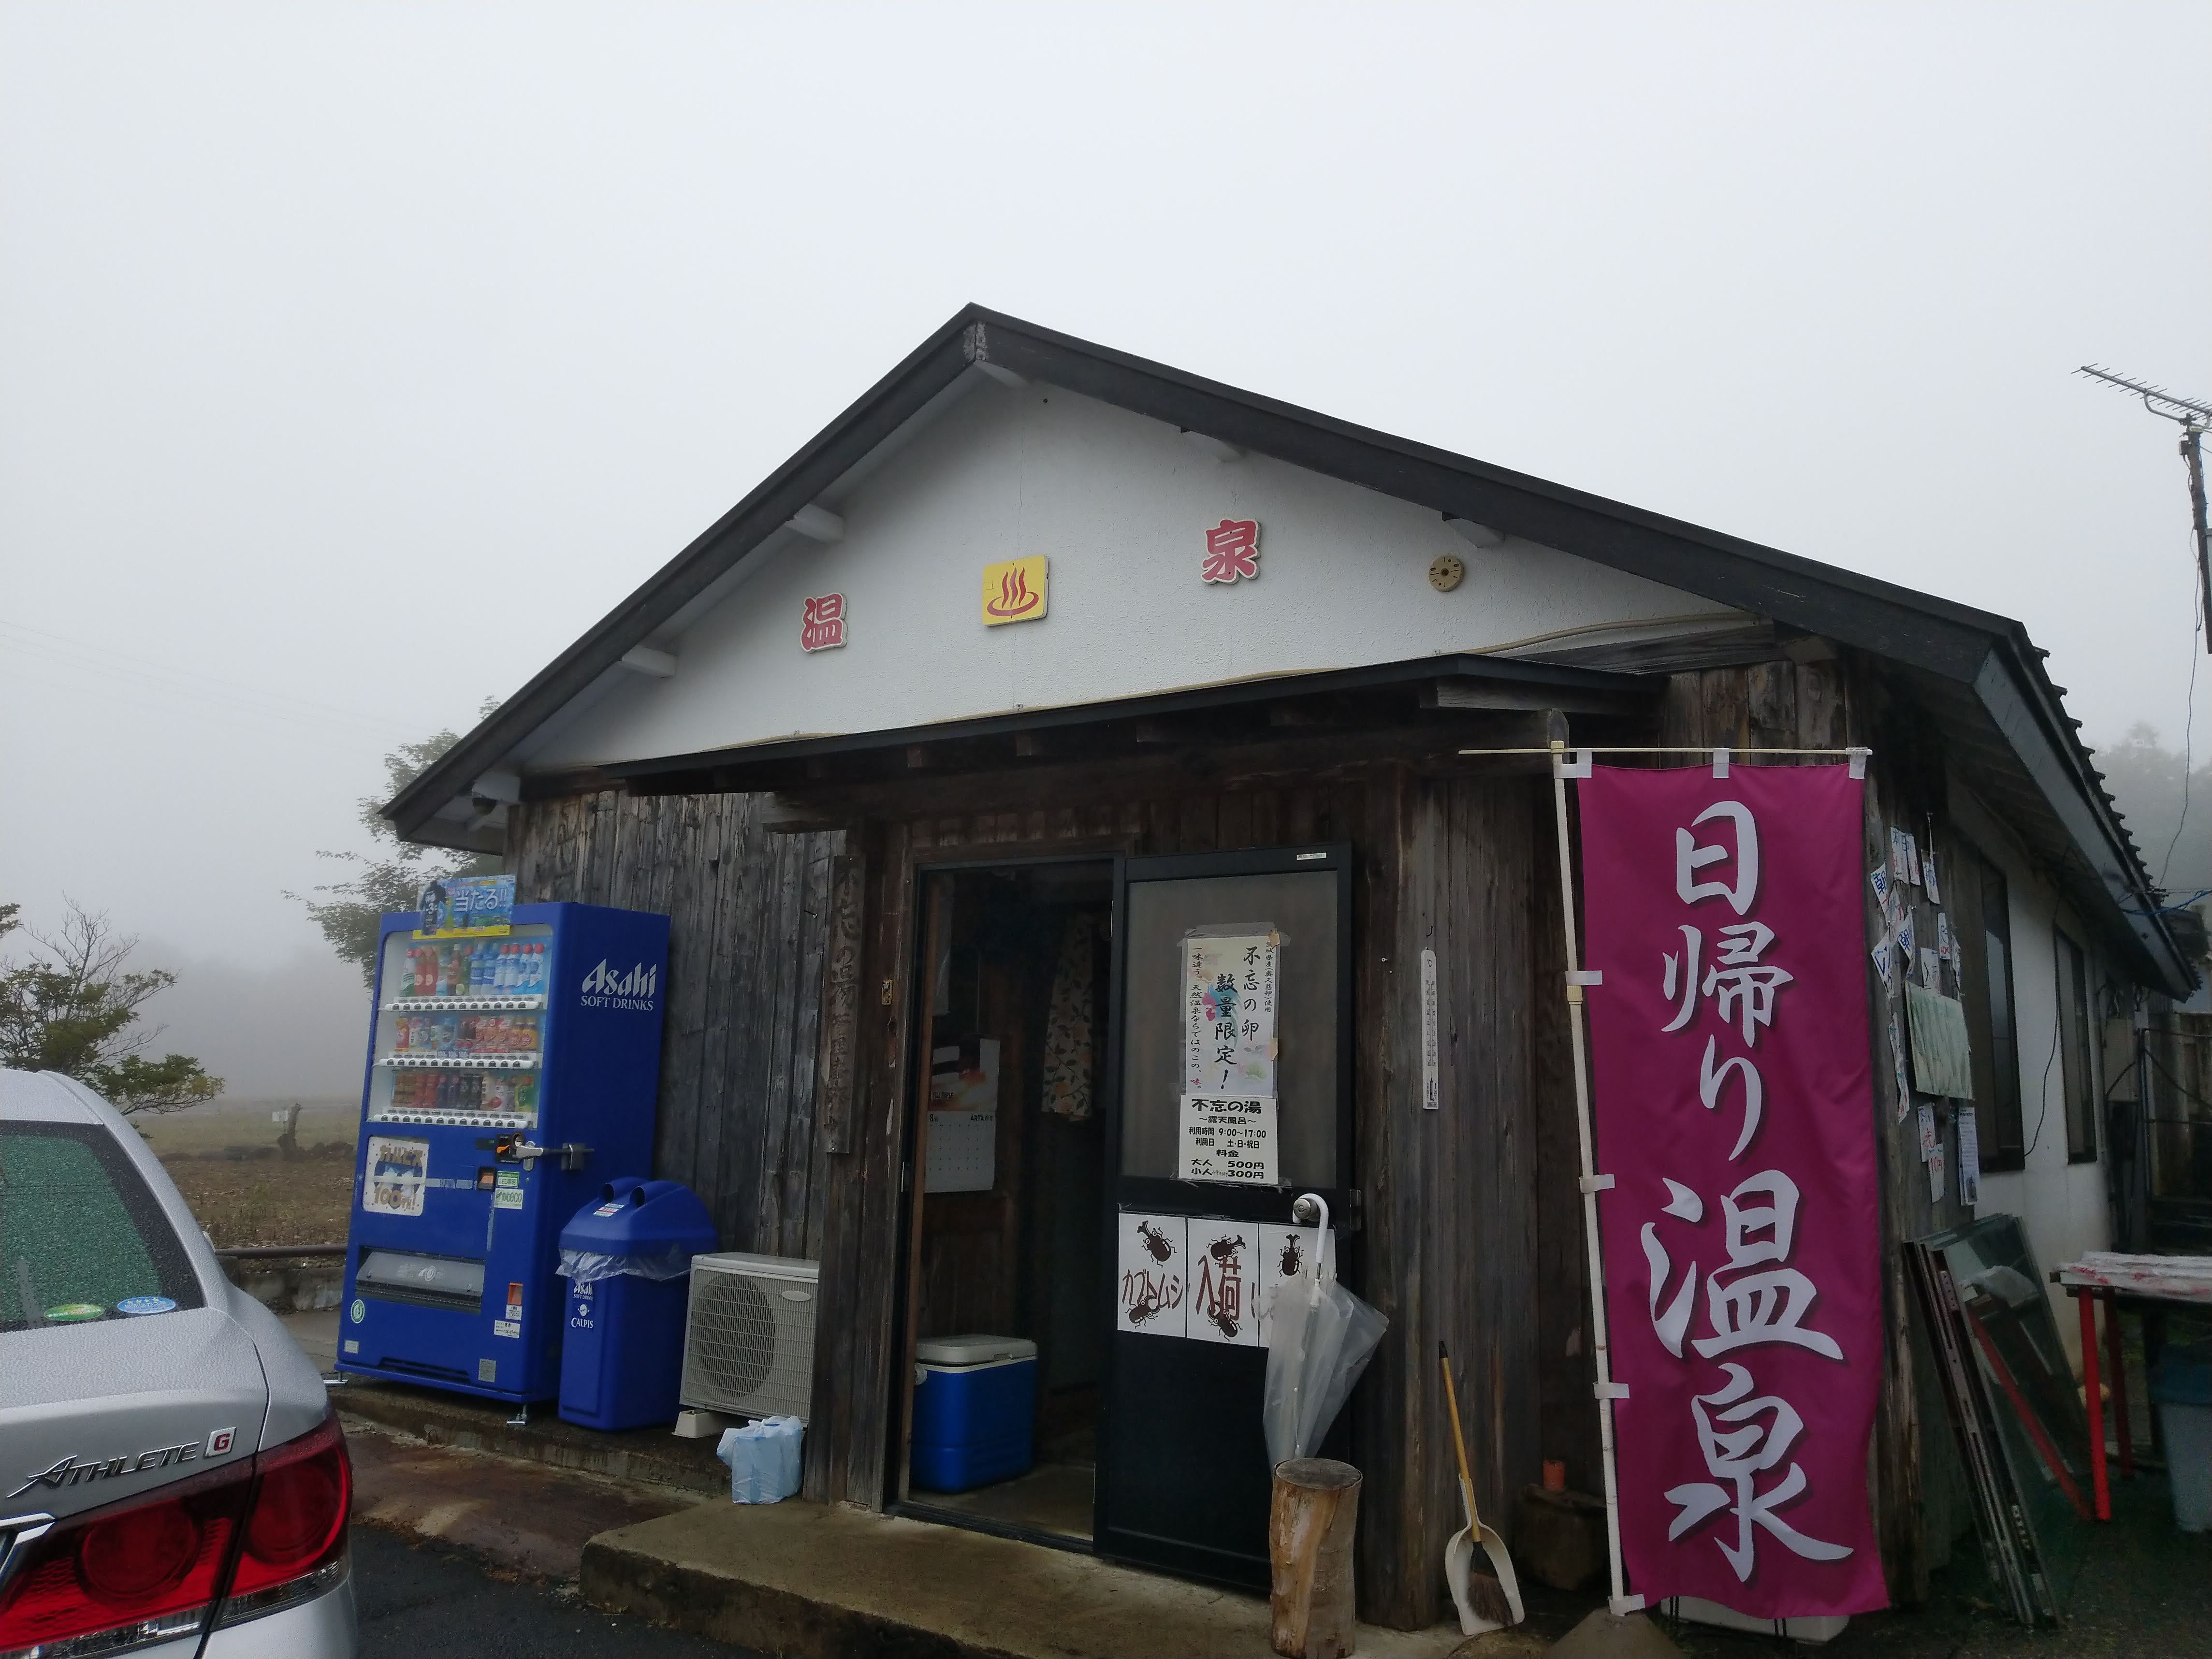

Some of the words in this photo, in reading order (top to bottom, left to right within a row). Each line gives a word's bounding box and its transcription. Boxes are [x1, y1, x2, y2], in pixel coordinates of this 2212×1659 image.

[801, 591, 847, 654] 温
[1201, 518, 1261, 584] 泉
[582, 959, 656, 998] Asahi
[1241, 946, 1260, 1041] 不忘の卵
[581, 995, 610, 1007] SOFT
[612, 998, 653, 1011] DRINKS
[1214, 973, 1238, 1090] 数量限定！
[1192, 1099, 1262, 1114] 不忘の湯
[1189, 1126, 1214, 1136] 利用時間
[1195, 1137, 1214, 1146] 利用日
[1227, 1139, 1259, 1149] 土・日・祝日
[1216, 1149, 1239, 1157] 料金
[1191, 1158, 1212, 1166] 大人
[1227, 1161, 1264, 1170] 500円
[1191, 1167, 1212, 1176] 小人
[1227, 1170, 1264, 1179] 300円
[1645, 800, 1854, 1584] 日帰り温泉
[1122, 1268, 1184, 1309] カブトムシ
[571, 1317, 594, 1328] CALPIS
[6, 1441, 200, 1498] ATHLETE
[214, 1434, 230, 1451] G
